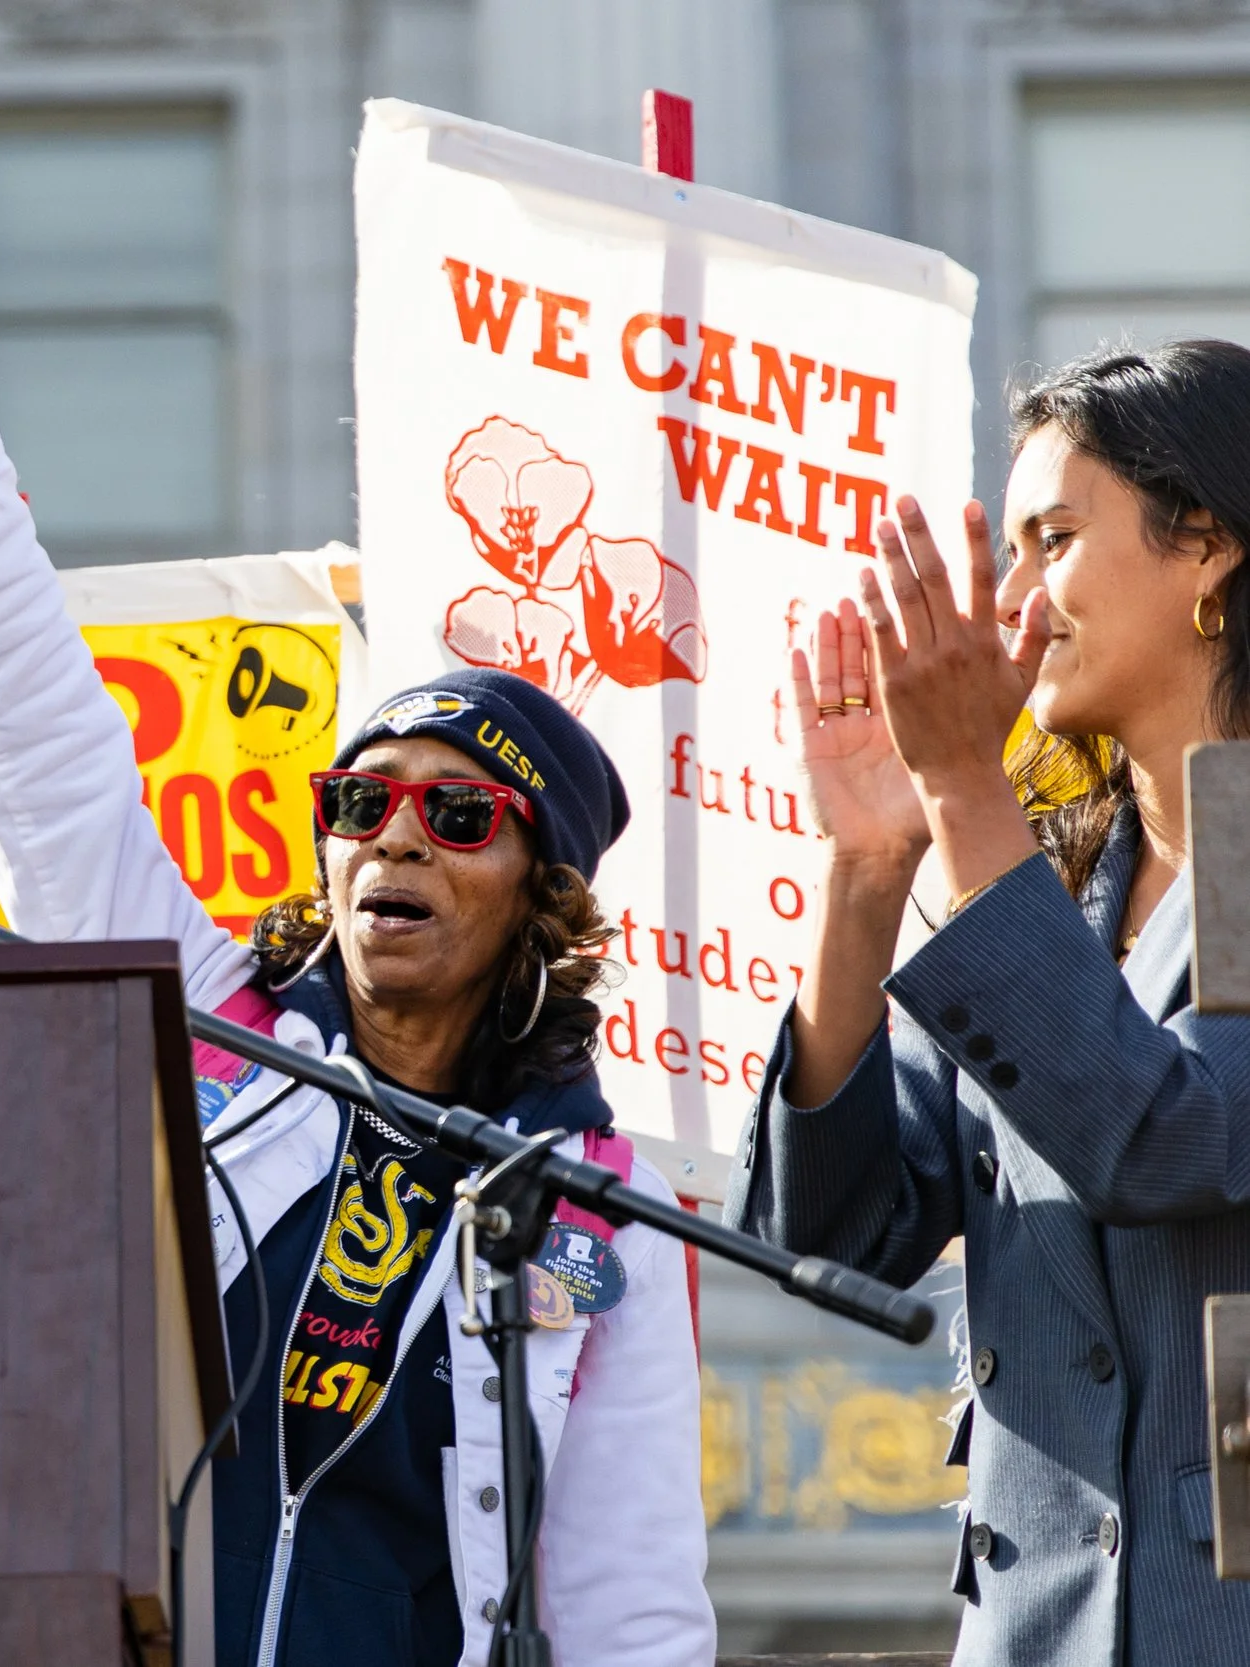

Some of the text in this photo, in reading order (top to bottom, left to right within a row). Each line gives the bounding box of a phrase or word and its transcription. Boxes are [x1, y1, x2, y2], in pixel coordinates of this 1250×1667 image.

[442, 256, 896, 455] WE CAN'T
[657, 417, 888, 558] WAIT
[476, 719, 546, 792] UESF
[670, 733, 826, 841] futu
[606, 998, 765, 1094] dese
[545, 1259, 603, 1288] fight for an
[578, 1263, 596, 1277] the
